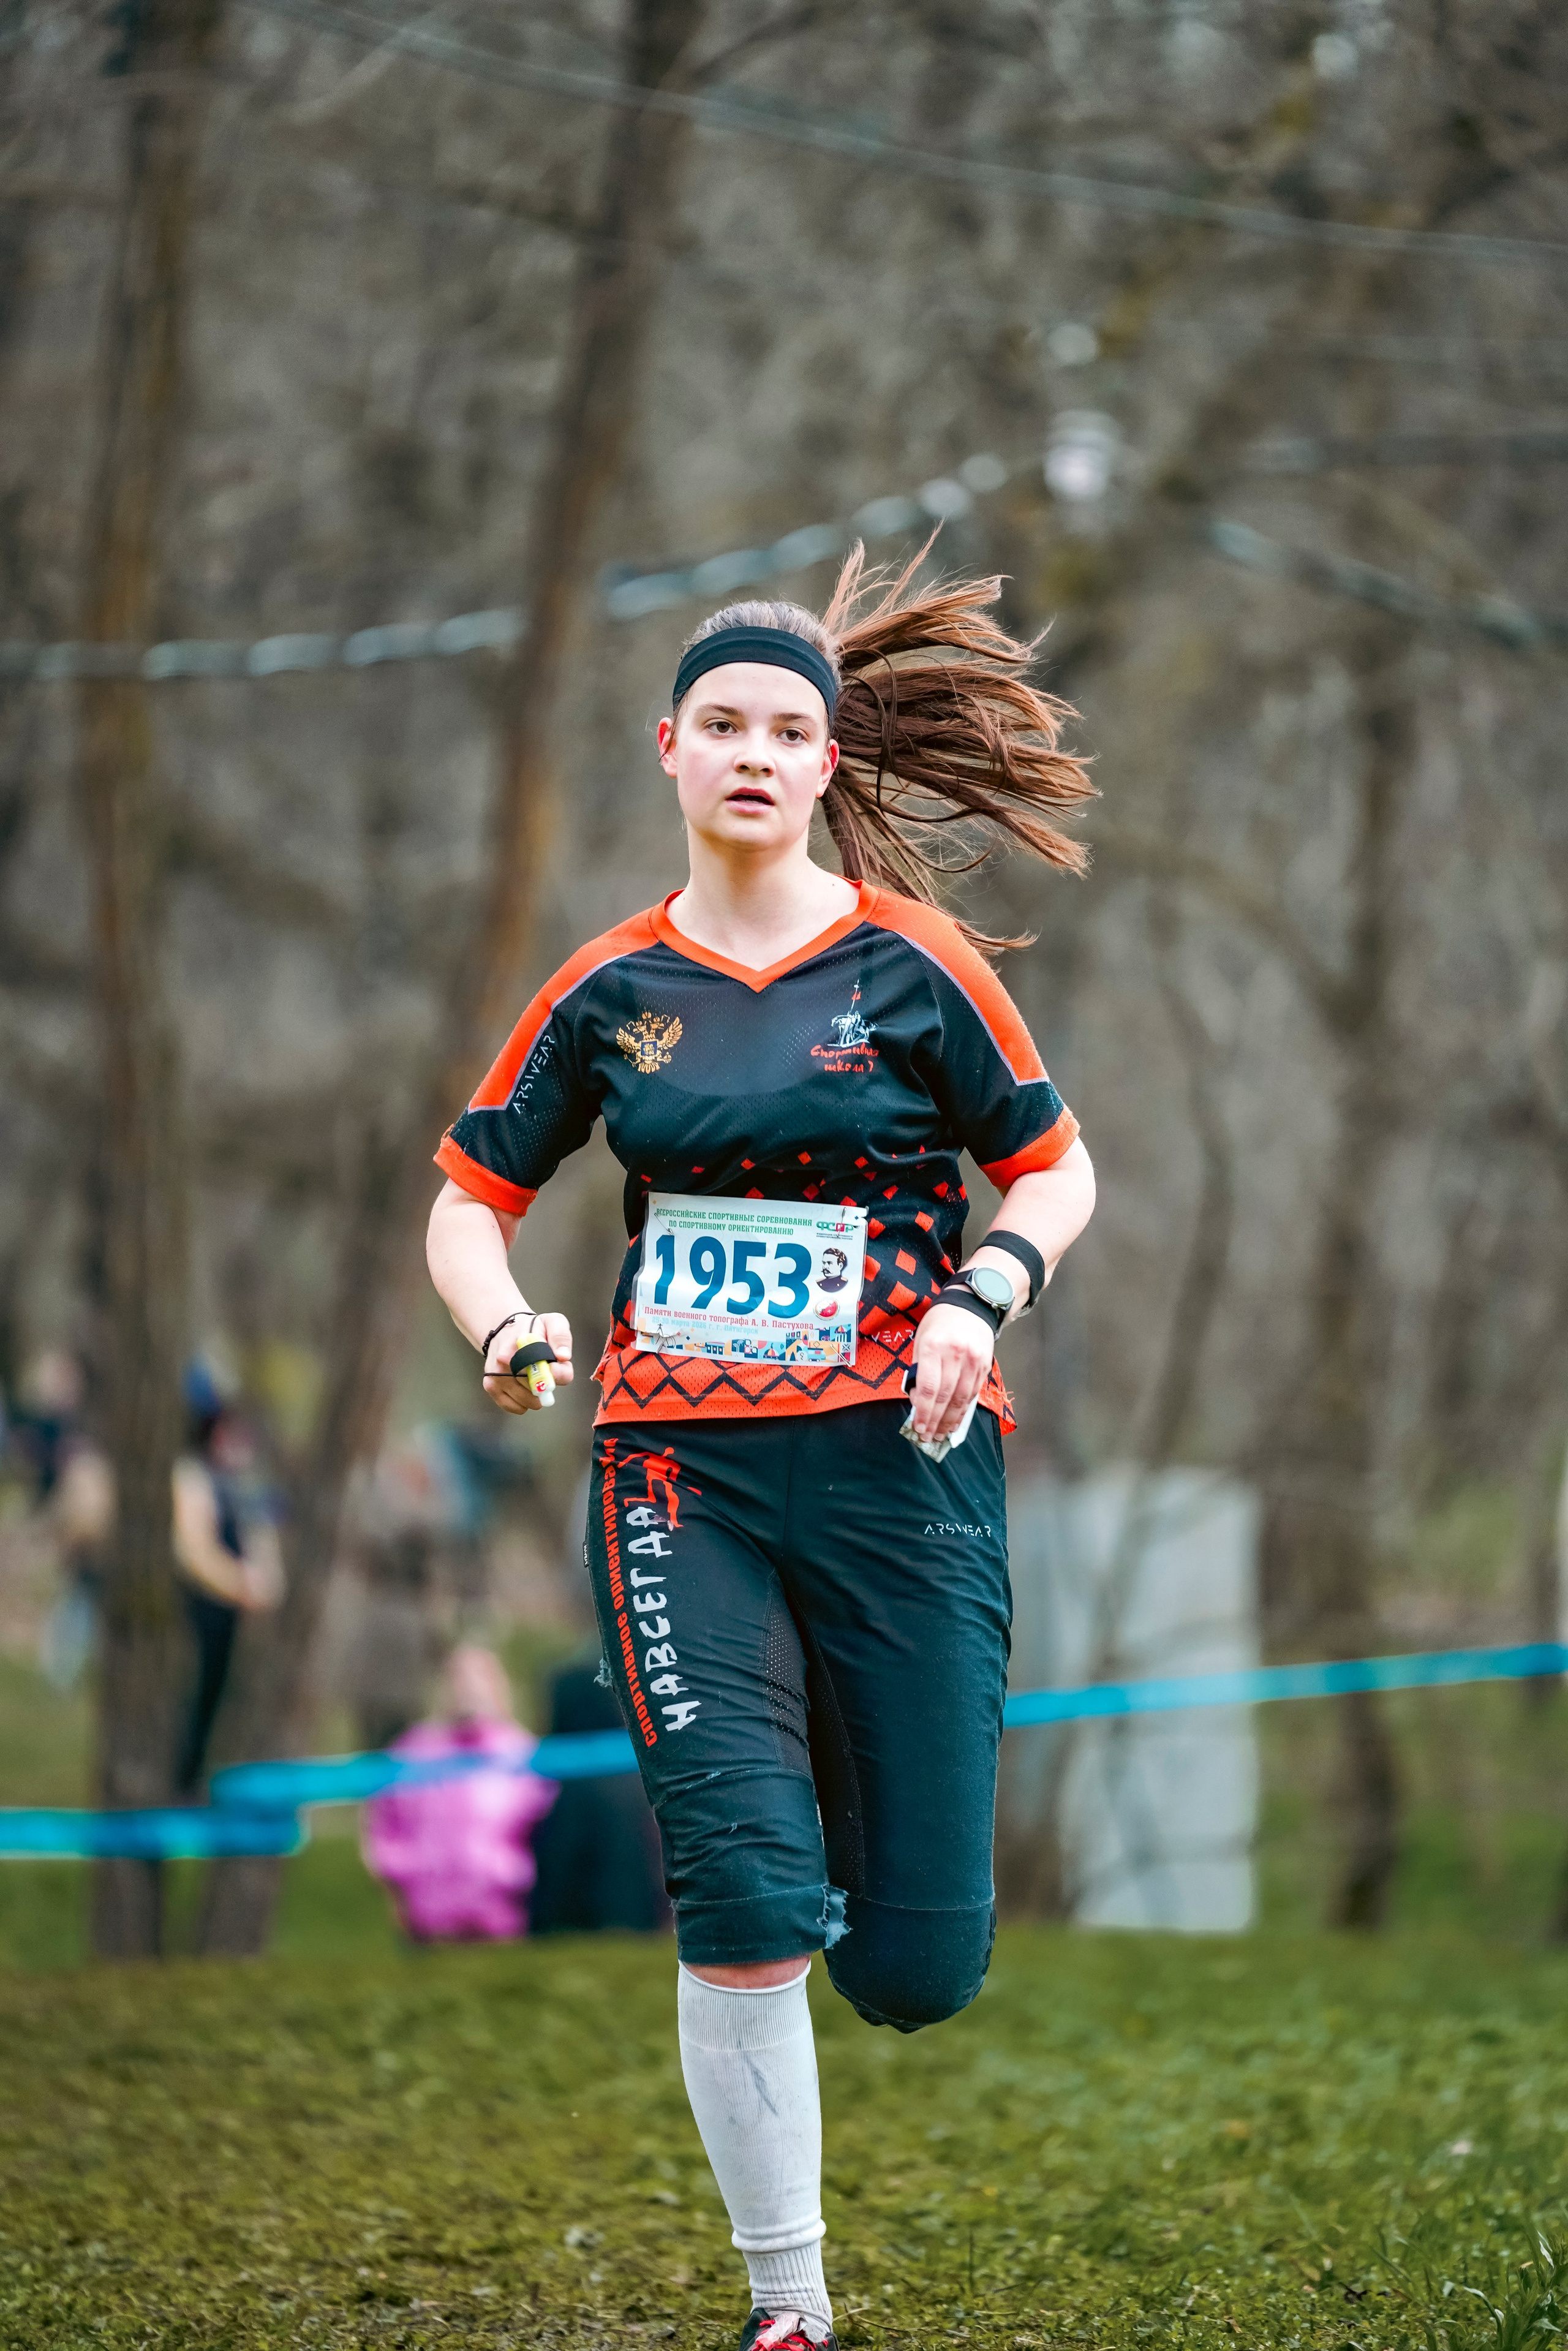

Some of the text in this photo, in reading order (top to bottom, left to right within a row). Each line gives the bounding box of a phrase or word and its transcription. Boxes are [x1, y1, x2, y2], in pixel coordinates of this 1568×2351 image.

[656, 1208, 813, 1226] ВСЕРОССИЙСКИЕ СПОРТИВНЫЕ СОРЕВНОВАНИЯ
[679, 1221, 726, 1231] СПОРТИВНОМУ
[728, 1224, 794, 1236] ОРИЕНТИРОВАНИЮ
[654, 1234, 812, 1319] 1953
[644, 1306, 671, 1317] Памяти
[674, 1311, 707, 1321] военного
[709, 1315, 748, 1326] топографа
[752, 1318, 758, 1327] А.
[772, 1320, 814, 1330] Пастухова
[625, 1506, 702, 1732] НАВСЕГДА
